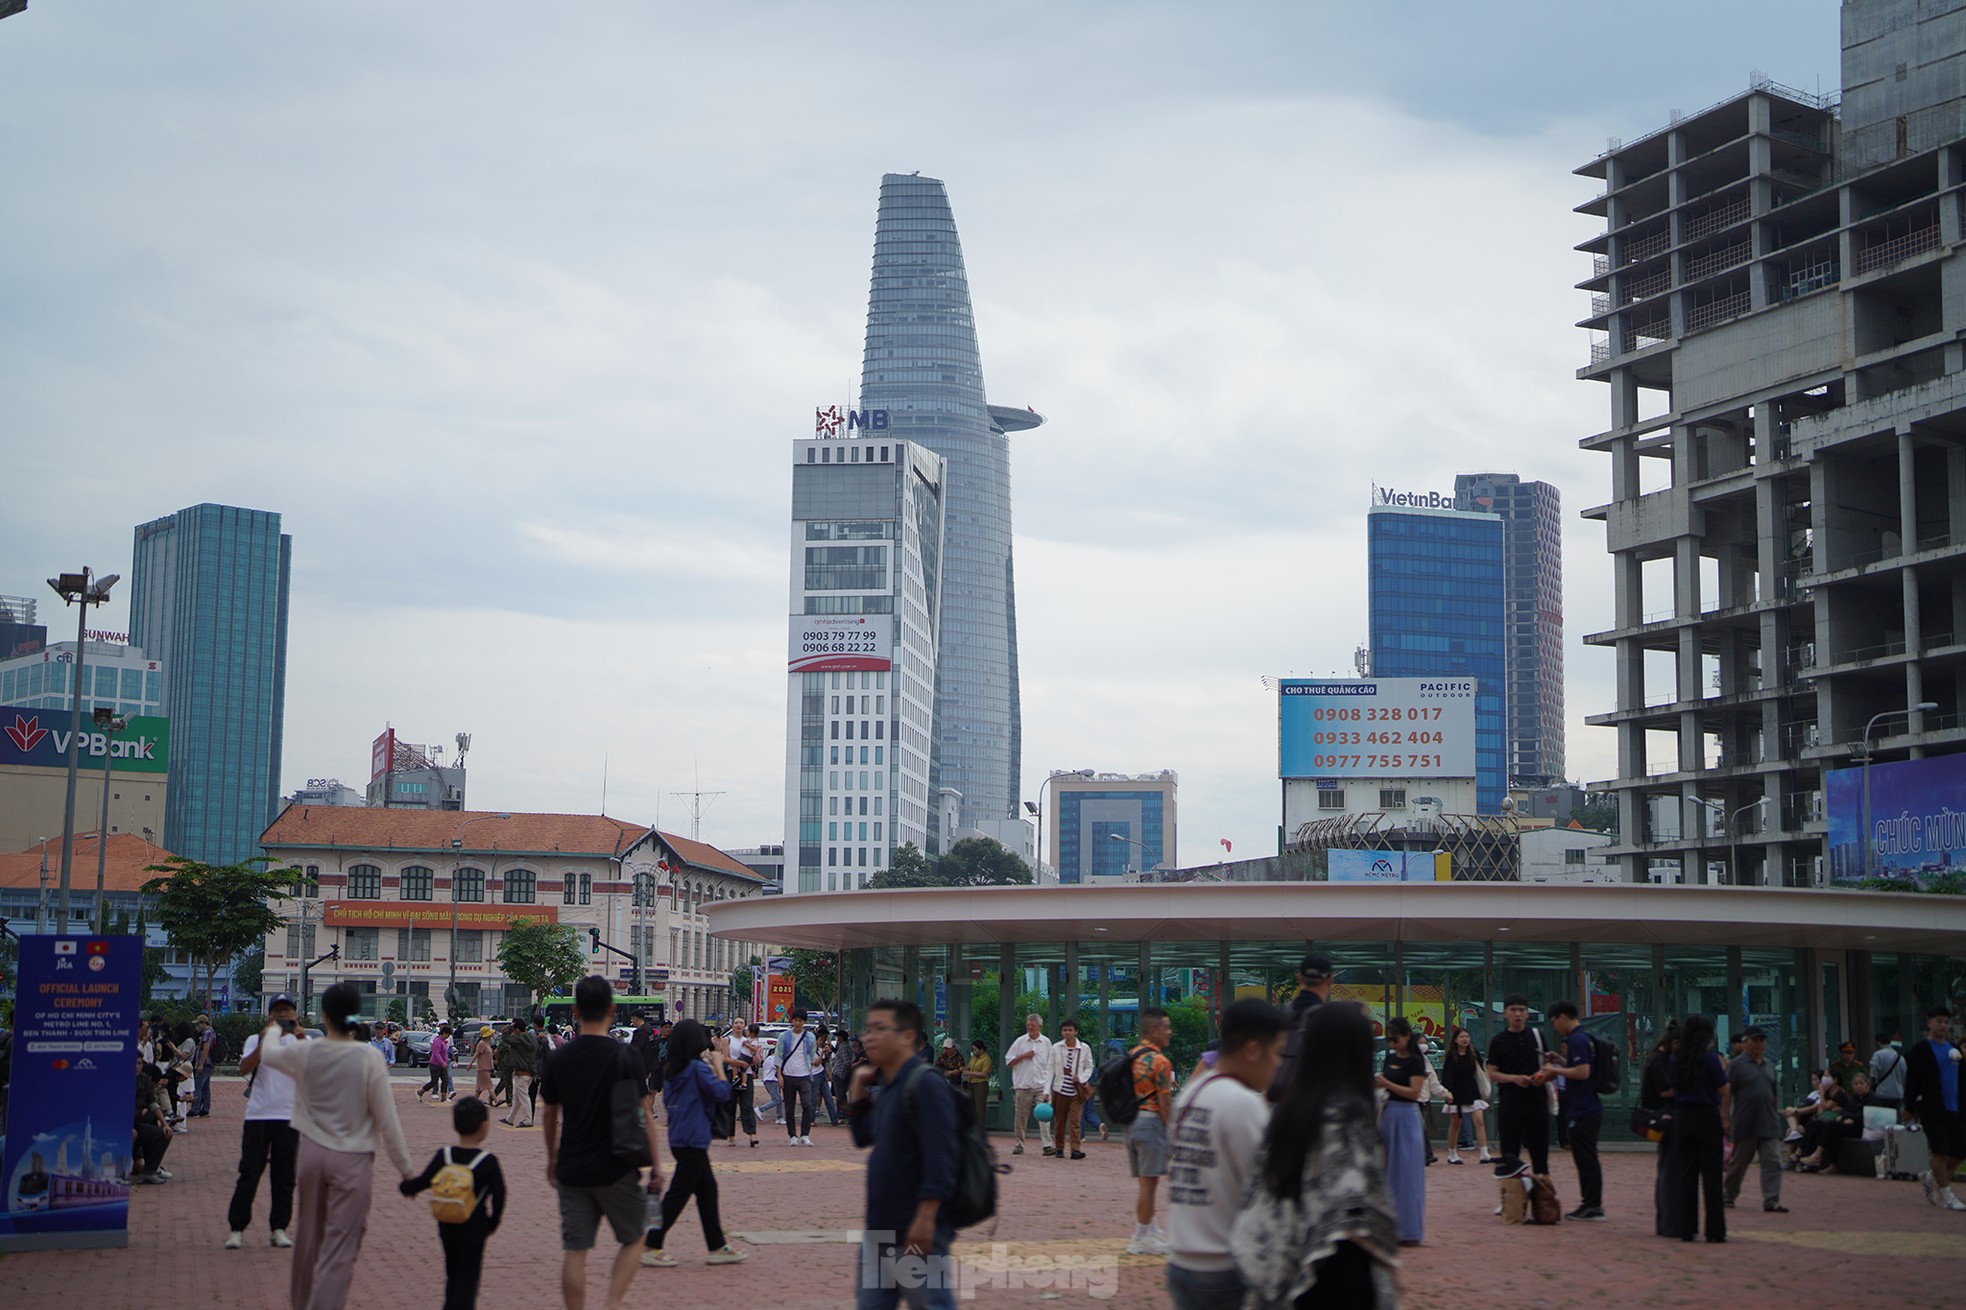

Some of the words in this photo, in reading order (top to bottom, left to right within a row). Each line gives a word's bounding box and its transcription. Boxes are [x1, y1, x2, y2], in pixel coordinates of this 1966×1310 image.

[849, 410, 889, 430] MB
[1380, 487, 1456, 510] VietinBa
[83, 629, 130, 642] SUNWAH
[802, 631, 829, 641] 0903
[832, 631, 845, 641] 79
[847, 631, 860, 641] 77
[863, 631, 876, 640] 99
[802, 643, 829, 653] 0906
[831, 643, 845, 653] 68
[847, 643, 860, 652] 22
[863, 643, 876, 652] 22
[56, 652, 73, 663] citi
[1285, 686, 1303, 694] CHO
[1304, 685, 1326, 694] THUÊ
[1327, 684, 1357, 695] QUẢNG
[1358, 684, 1375, 694] CÁO
[1420, 683, 1471, 691] PACIFIC
[1314, 708, 1361, 721] 0908
[1367, 708, 1402, 721] 328
[1407, 708, 1443, 721] 017
[52, 730, 155, 759] VPBank
[1314, 732, 1361, 745] 0933
[1367, 732, 1402, 745] 462
[1407, 732, 1443, 745] 404
[1314, 755, 1361, 768] 0977
[1367, 755, 1402, 768] 755
[1407, 755, 1441, 768] 751
[1876, 810, 1921, 856] CHÚC
[334, 908, 346, 919] CHỦ
[348, 909, 363, 920] TỊCH
[364, 908, 372, 919] HỒ
[373, 909, 385, 919] CHÍ
[385, 910, 401, 919] MINH
[422, 909, 438, 920] SỐNG
[483, 912, 505, 922] NGHIỆP
[541, 914, 549, 923] TA
[40, 983, 79, 993] OFFICIAL
[82, 983, 119, 993] LAUNCH
[54, 998, 103, 1008] CEREMONY
[97, 1011, 121, 1019] CITY'S
